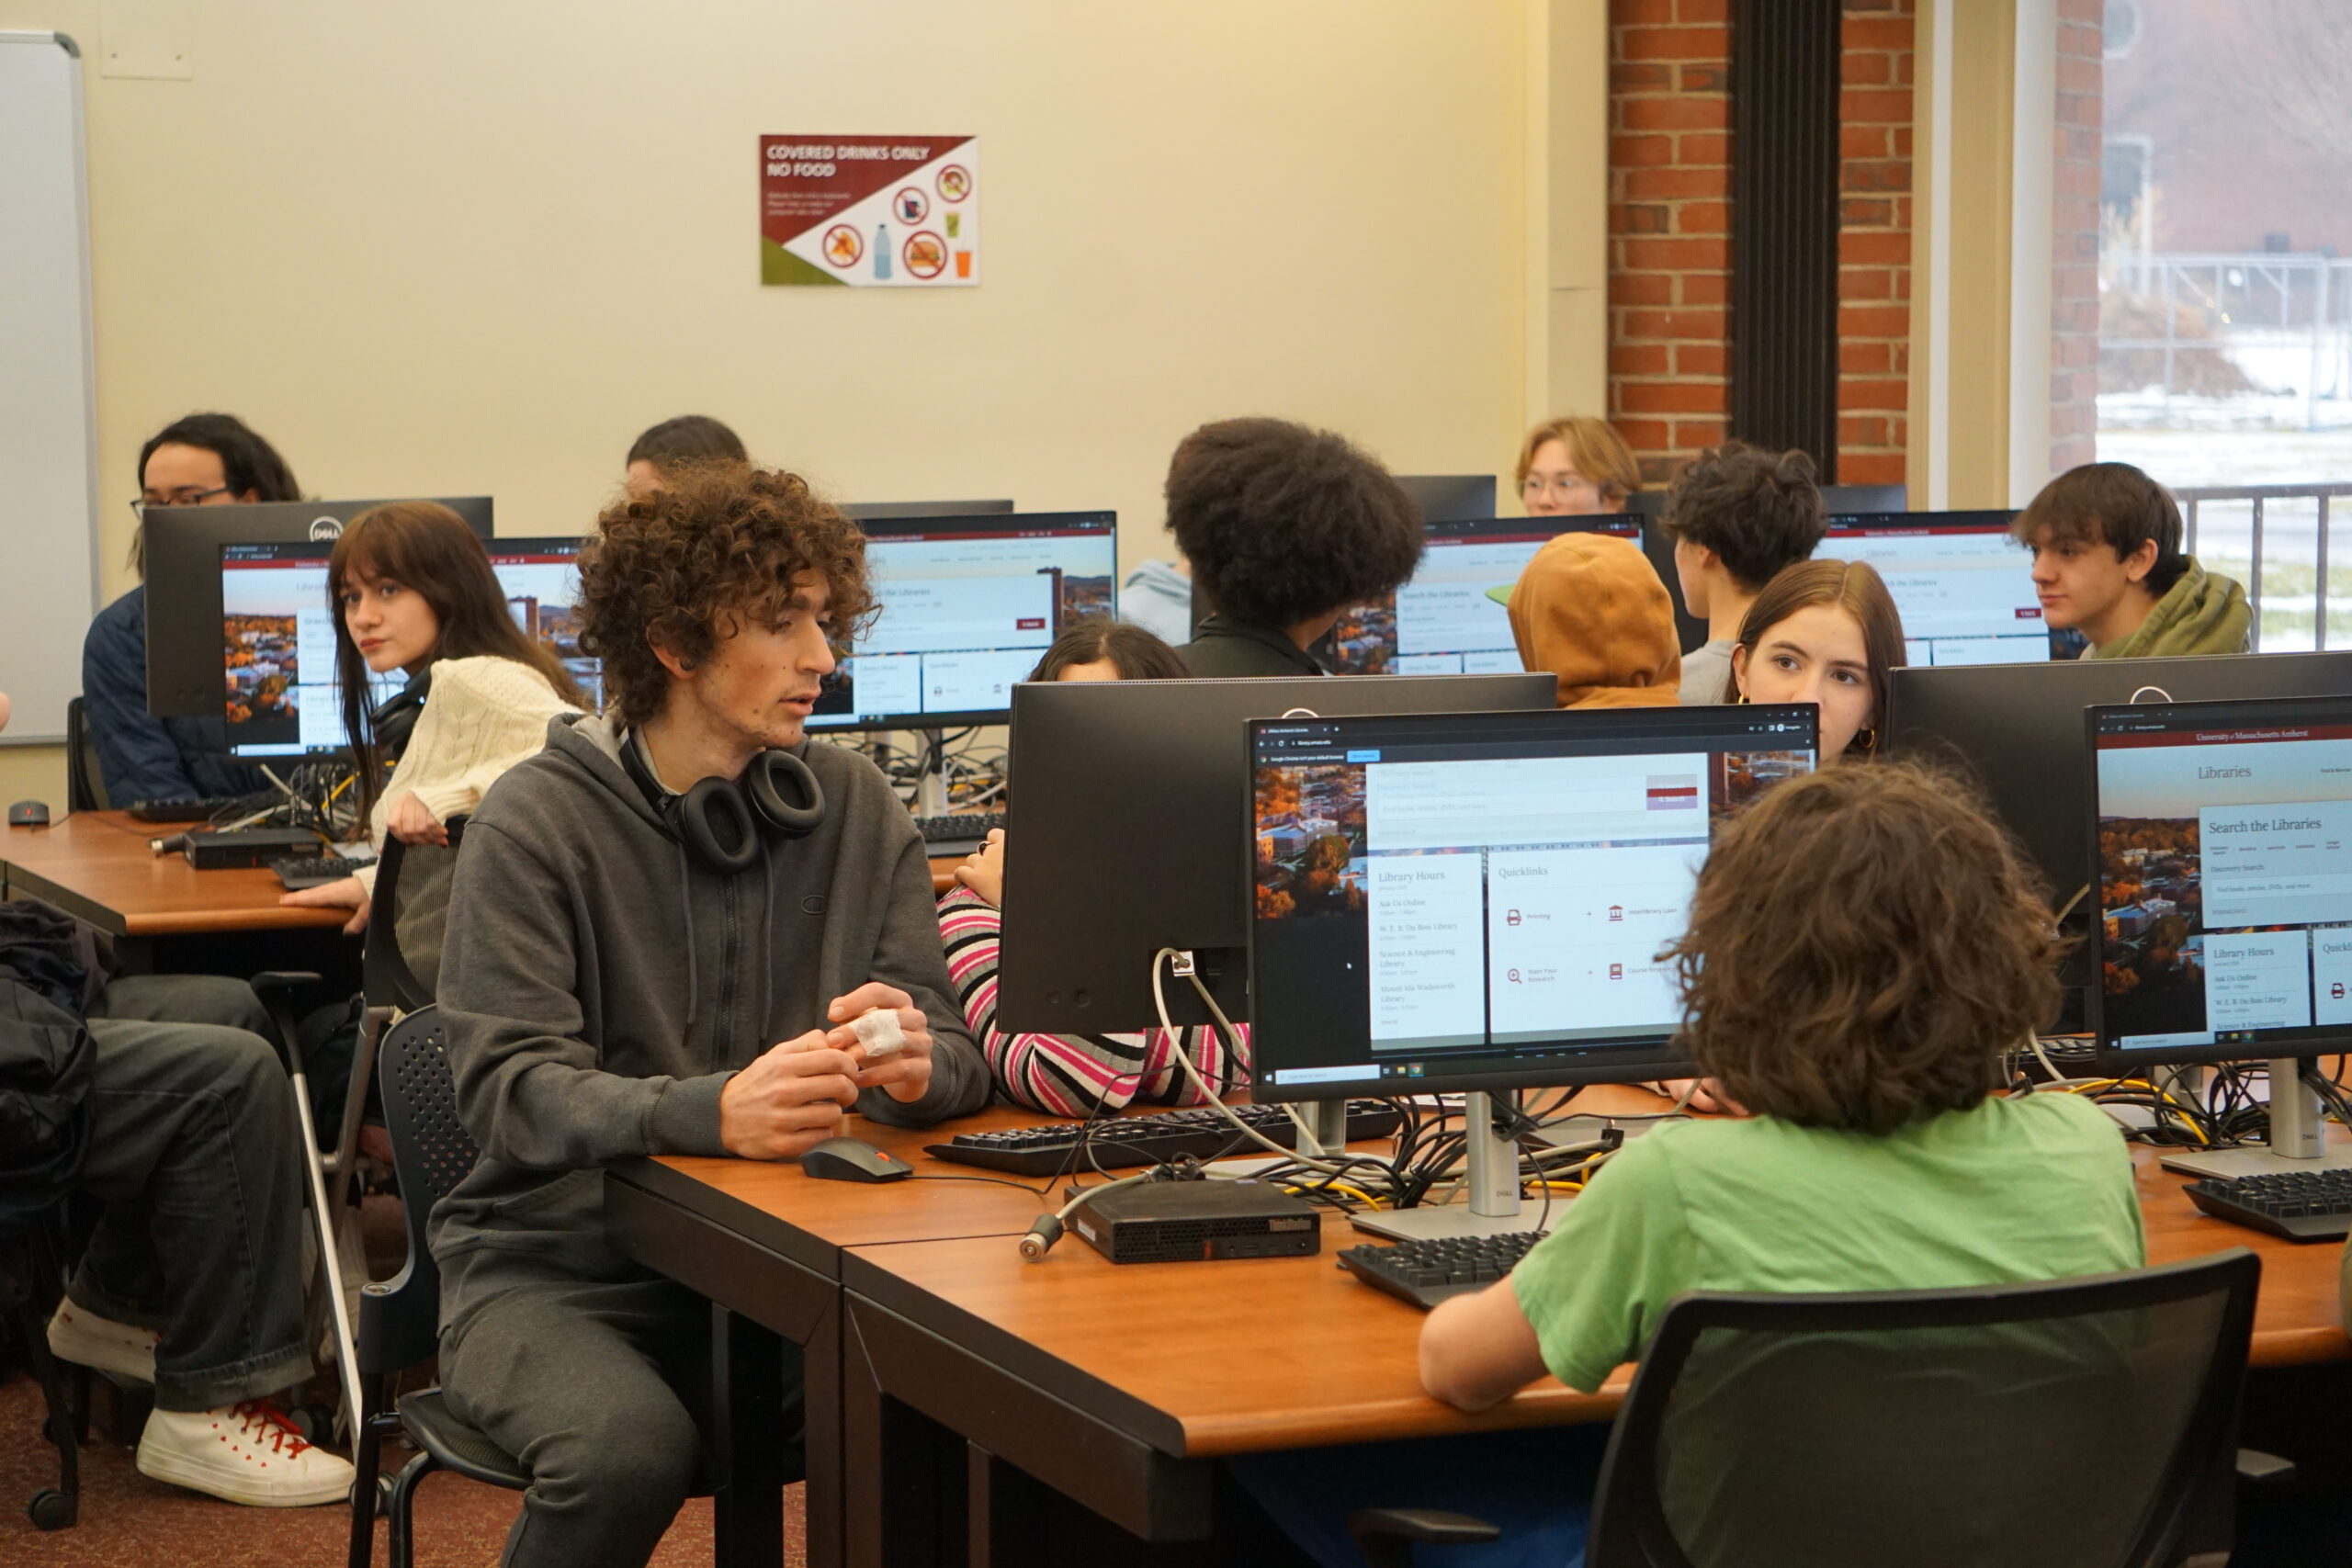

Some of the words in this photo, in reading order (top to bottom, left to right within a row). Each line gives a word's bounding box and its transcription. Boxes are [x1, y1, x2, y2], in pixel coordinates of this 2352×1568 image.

[766, 145, 835, 160] COVERED
[836, 145, 890, 160] DRINKS
[890, 146, 931, 160] ONLY
[766, 163, 792, 177] NO
[793, 163, 836, 177] FOOD
[2199, 764, 2252, 780] Libraries
[2209, 819, 2248, 834] Search
[2251, 819, 2269, 832] the
[2272, 818, 2323, 831] Libraries
[1378, 872, 1413, 884] Library
[1416, 871, 1446, 881] Hours
[1498, 866, 1549, 879] Quicklinks
[1379, 900, 1391, 908] Ask
[1403, 898, 1426, 907] Online
[1433, 922, 1458, 931] Library
[1415, 948, 1455, 958] Engineering
[2213, 949, 2245, 960] Library
[2248, 947, 2275, 957] Hours
[1380, 960, 1405, 968] Library
[1381, 995, 1406, 1003] Library
[2265, 996, 2287, 1005] Library
[2216, 1022, 2240, 1031] Science
[2248, 1020, 2286, 1029] Engineering
